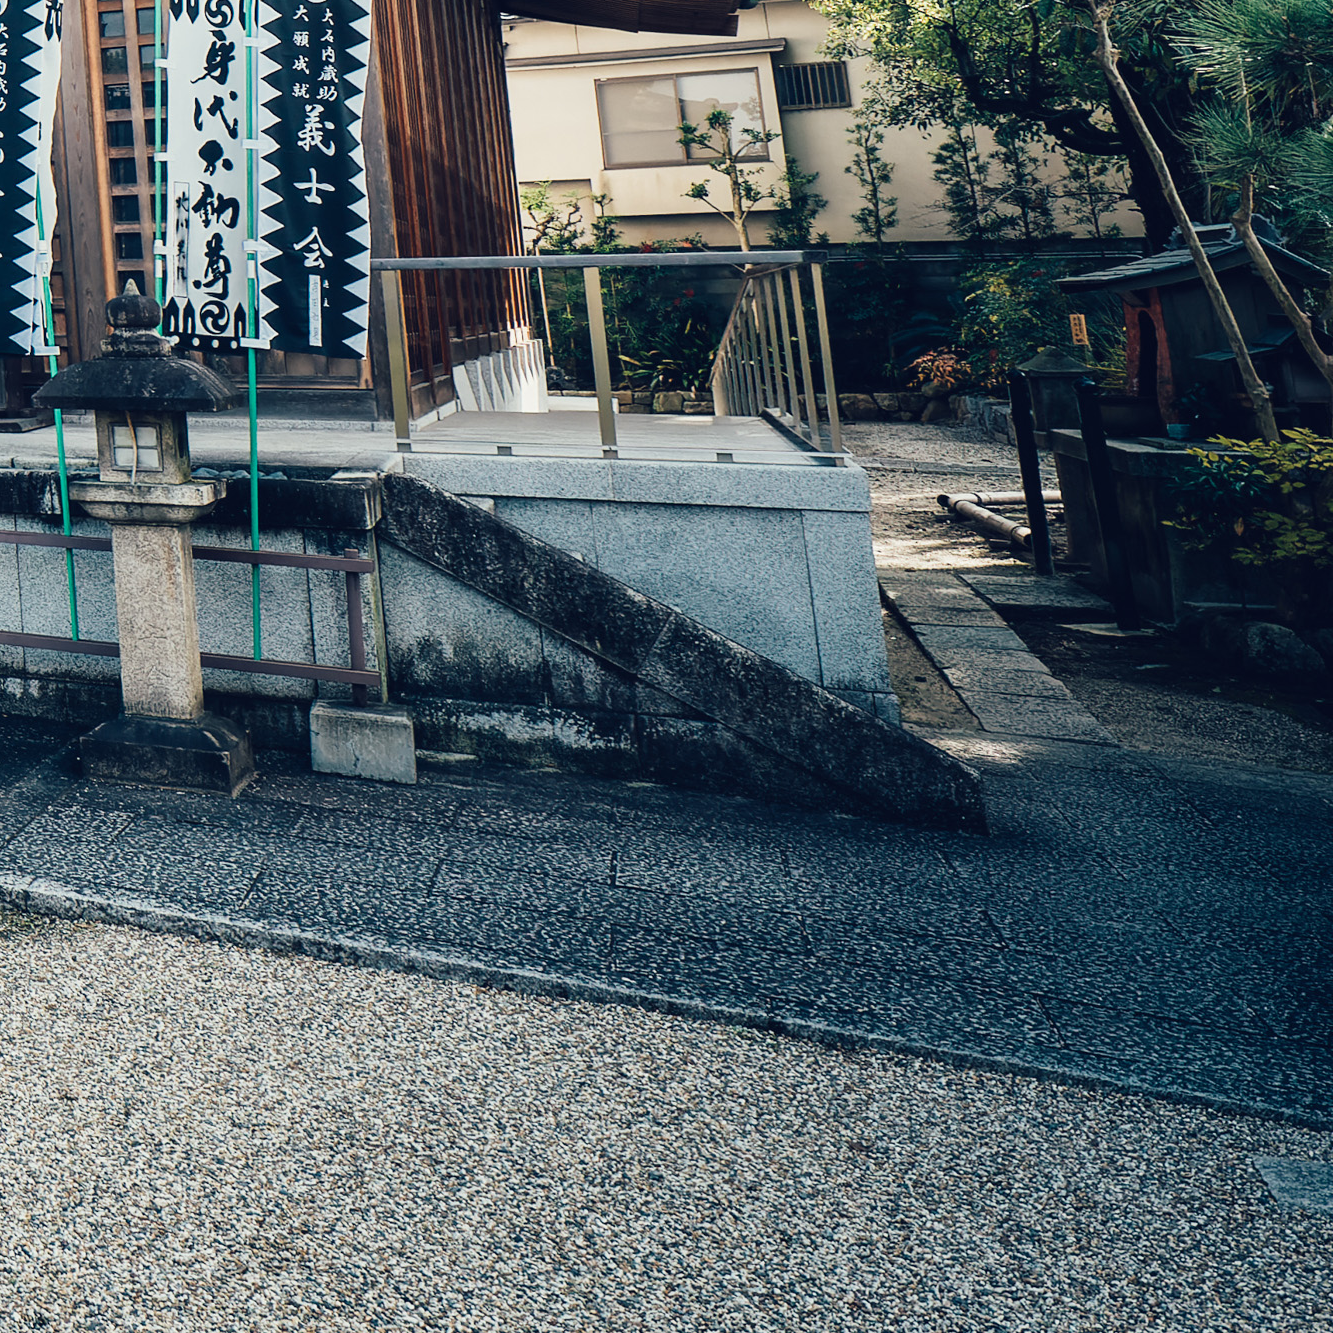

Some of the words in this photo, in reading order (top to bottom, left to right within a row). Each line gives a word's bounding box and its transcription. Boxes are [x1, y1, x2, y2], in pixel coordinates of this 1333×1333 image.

[292, 4, 310, 99] 大願成就
[317, 8, 339, 101] 大石内蔵助
[190, 30, 239, 301] 身代不動尊
[293, 104, 336, 269] 義士会
